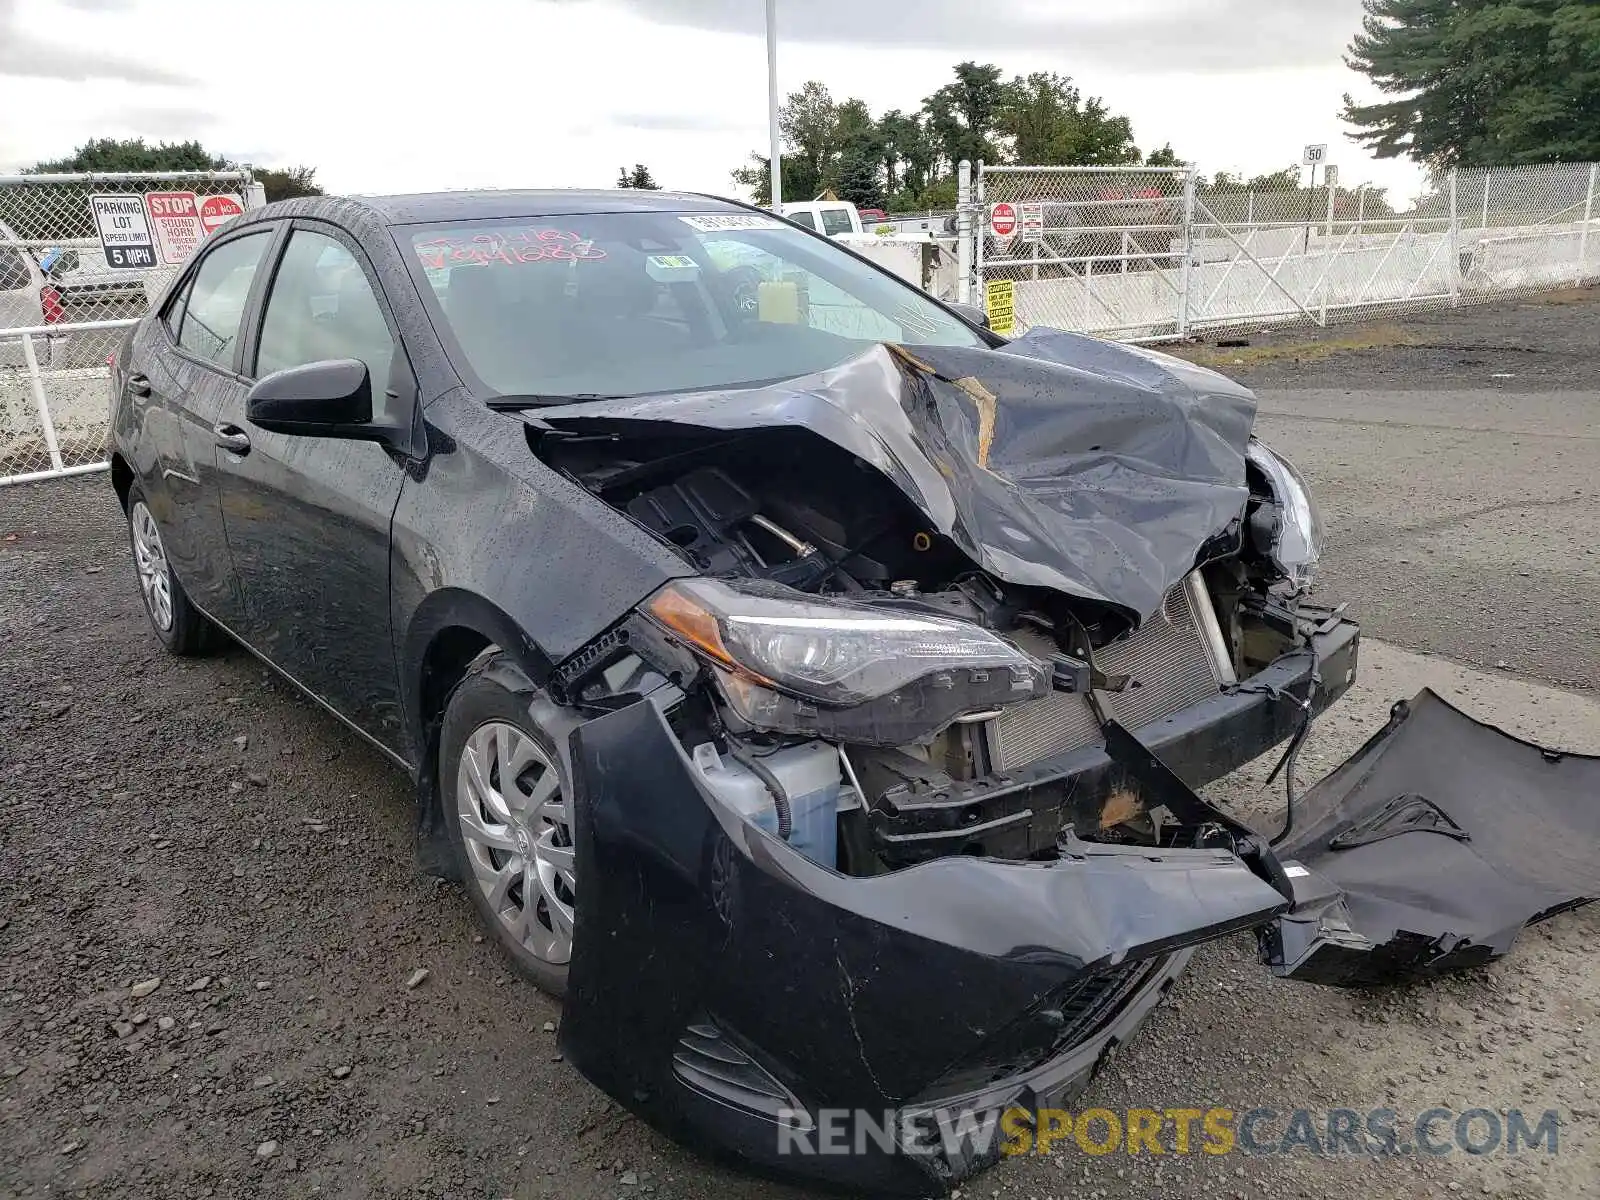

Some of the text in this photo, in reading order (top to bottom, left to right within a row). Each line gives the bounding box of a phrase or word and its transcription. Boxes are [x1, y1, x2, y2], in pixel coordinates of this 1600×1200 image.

[1308, 148, 1322, 161] 50
[97, 201, 141, 216] PARKING
[151, 198, 194, 214] STOP
[205, 204, 237, 215] DO NOT
[112, 217, 132, 229] LOT
[161, 218, 195, 228] SOUND
[104, 232, 148, 243] SPEED LIMIT
[166, 228, 194, 237] HORN
[112, 249, 152, 264] 5 MPH
[989, 283, 1012, 293] CAUTION
[990, 308, 1012, 317] CUIDADO
